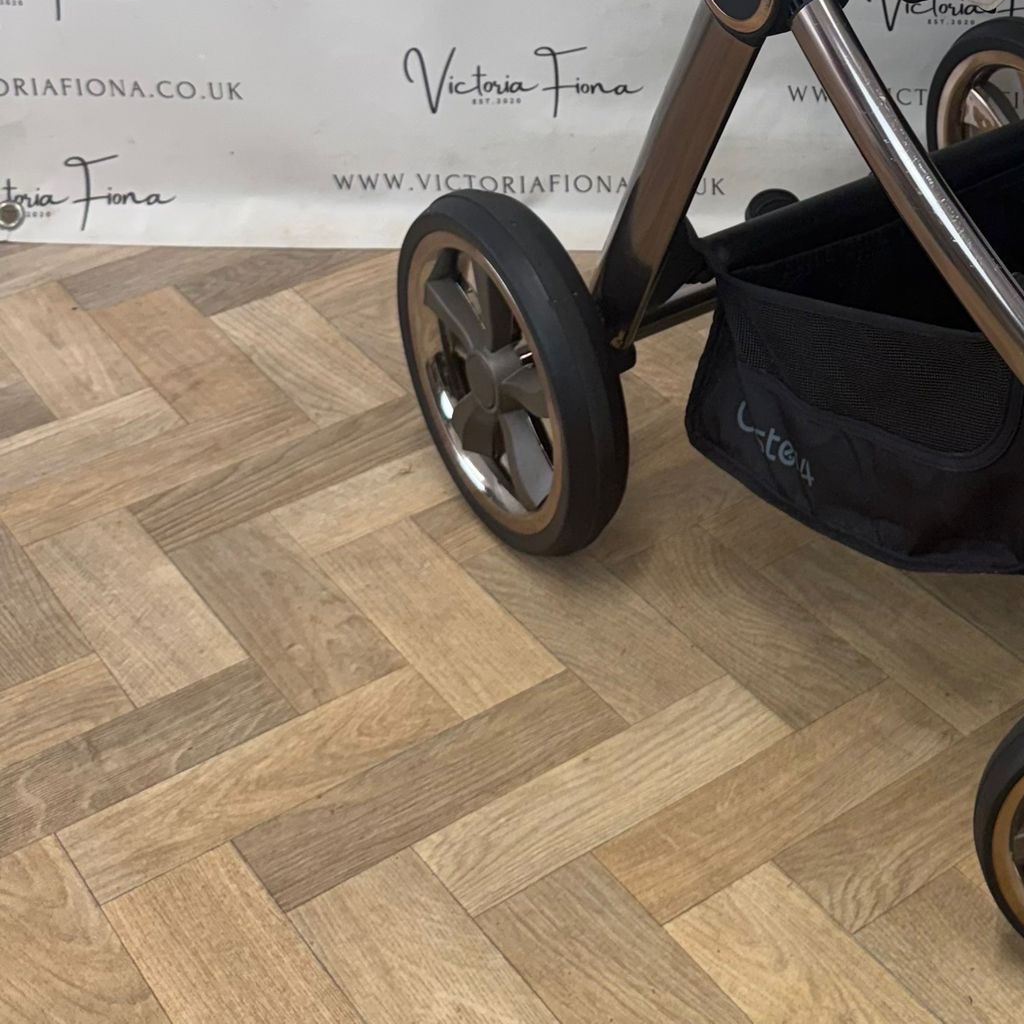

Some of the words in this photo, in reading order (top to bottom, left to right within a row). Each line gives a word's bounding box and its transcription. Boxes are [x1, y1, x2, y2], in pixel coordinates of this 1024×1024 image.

[404, 47, 538, 114] Victoria
[534, 47, 644, 118] Fiona
[64, 154, 176, 231] Fiona
